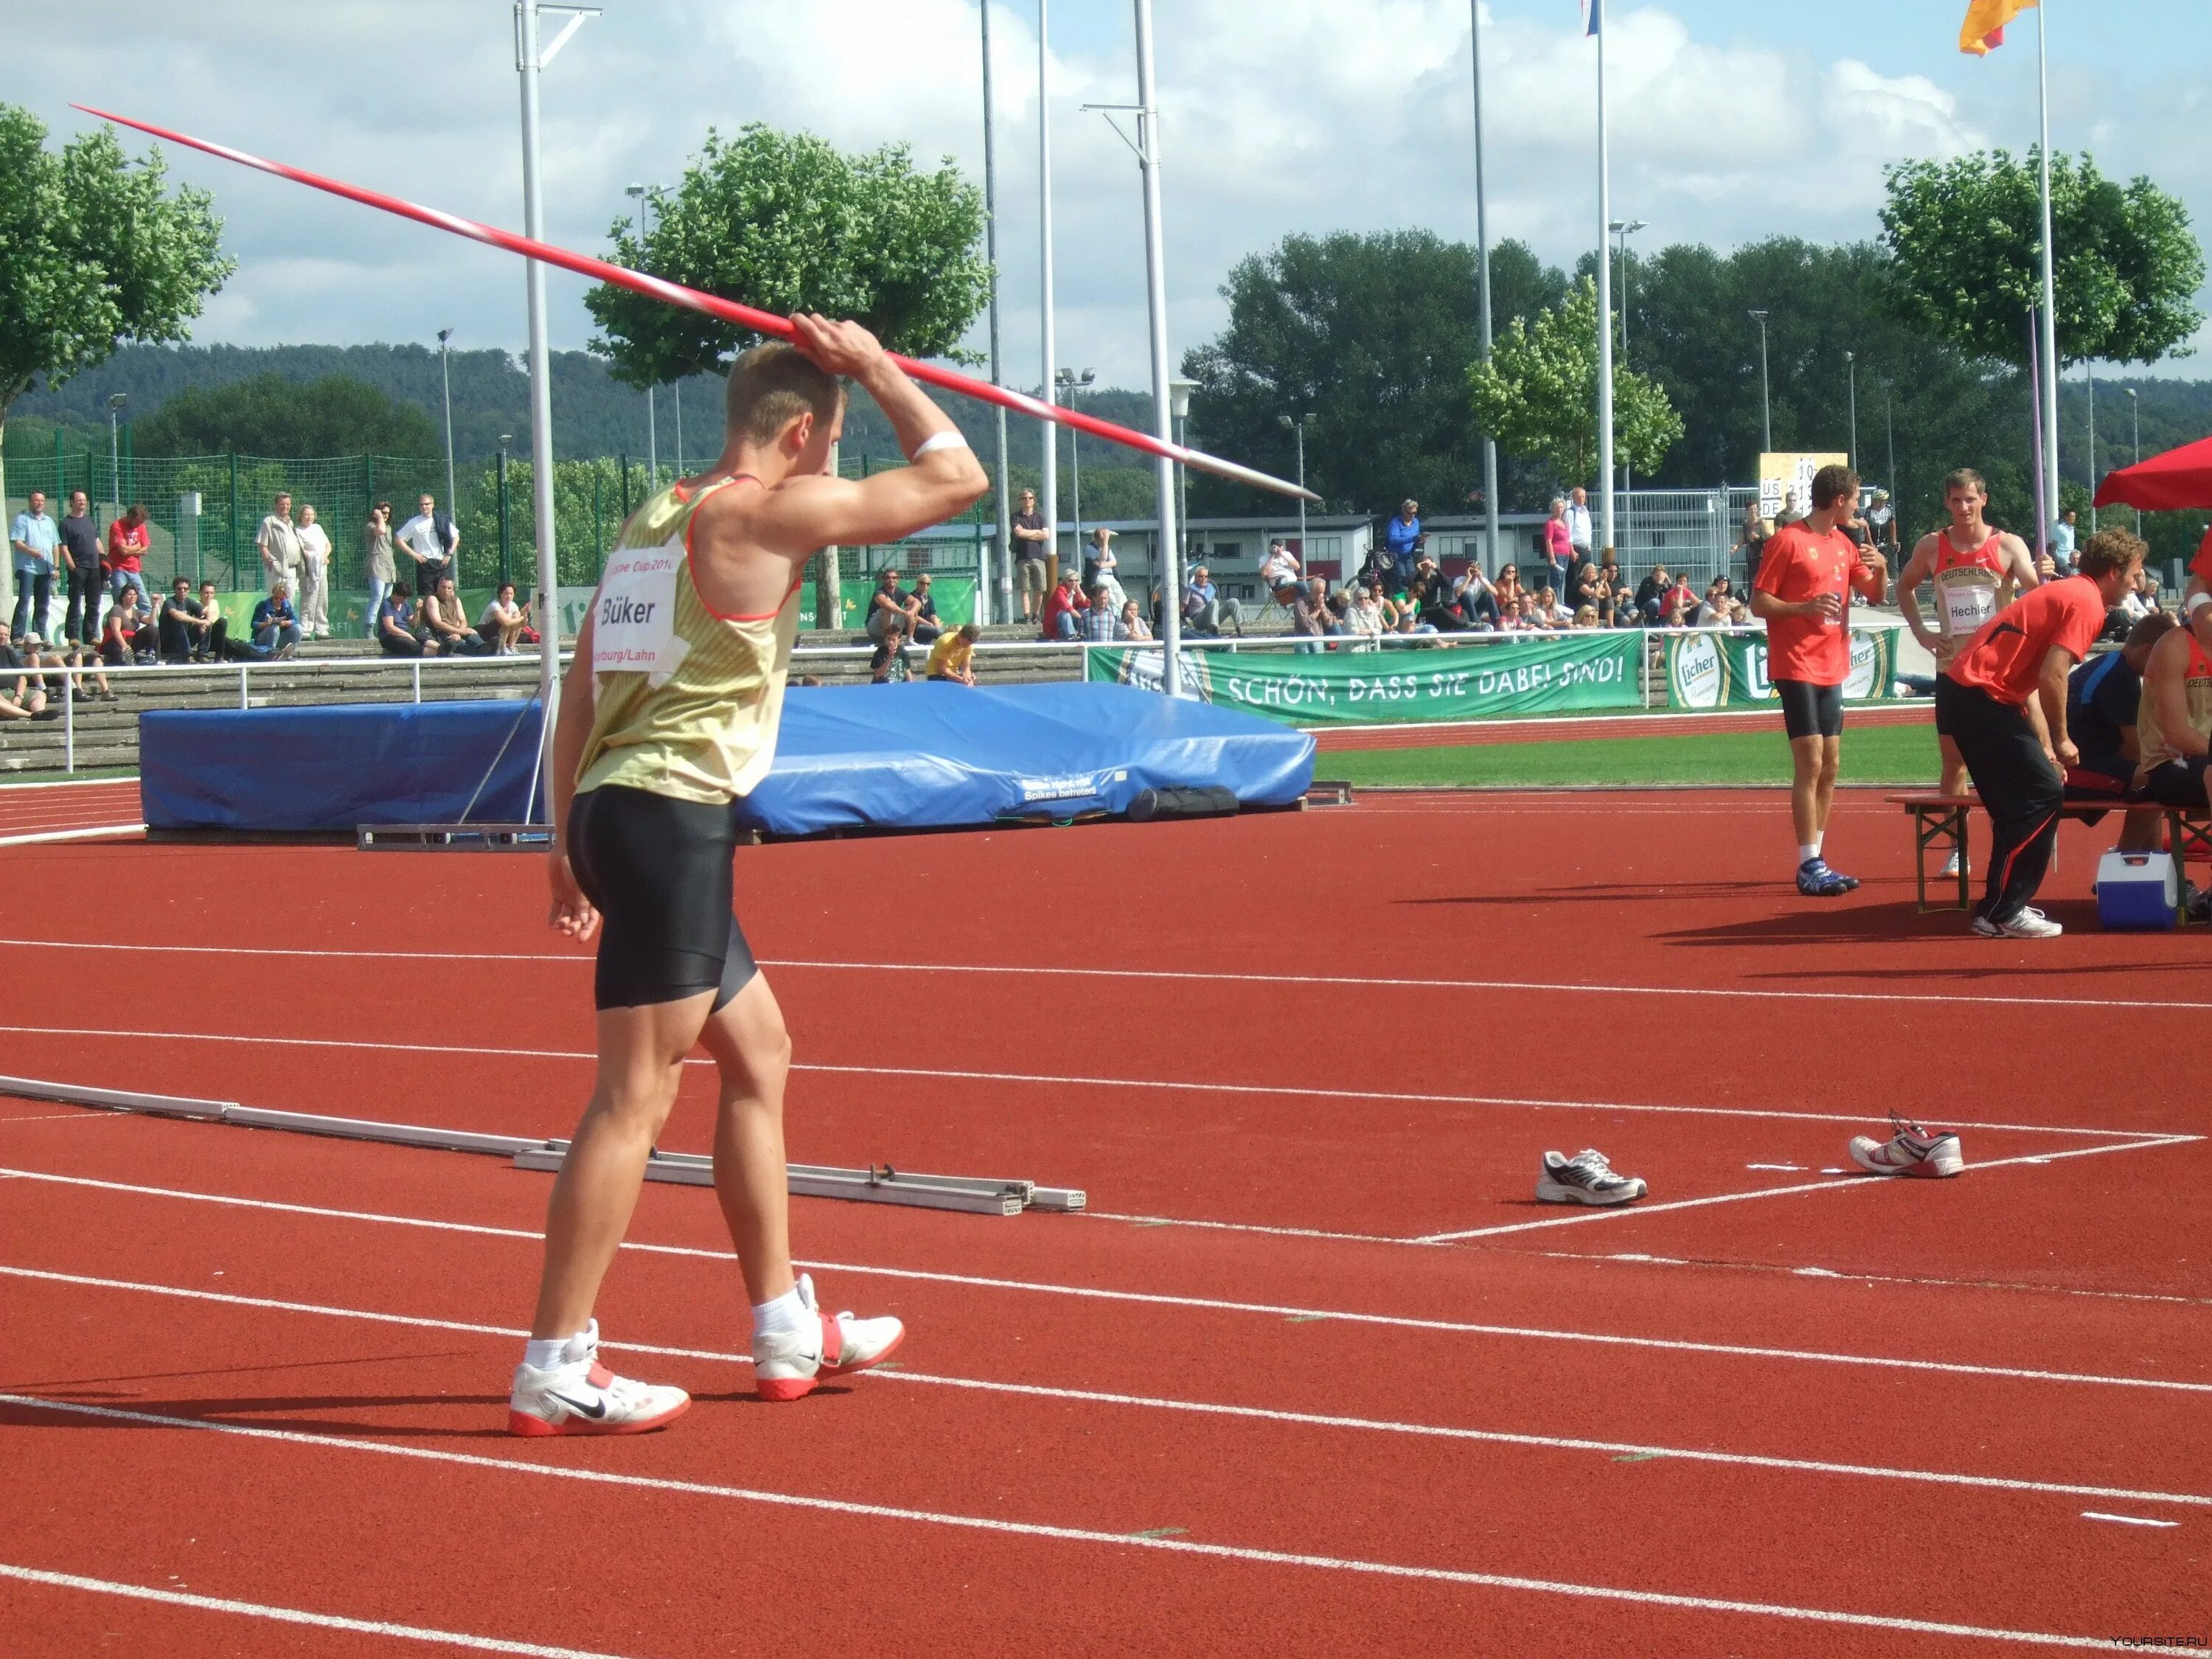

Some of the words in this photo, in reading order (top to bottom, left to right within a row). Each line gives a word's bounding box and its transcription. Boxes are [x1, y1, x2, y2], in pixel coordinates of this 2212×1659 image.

[1763, 483, 1779, 495] US
[1762, 503, 1779, 515] DE
[601, 595, 655, 625] Büker
[1950, 603, 1991, 618] Hechler
[1851, 649, 1871, 667] her
[1681, 655, 1715, 686] Licher
[1228, 673, 1335, 706] SCHÖN,
[1349, 675, 1418, 701] DASS
[1429, 672, 1470, 698] SIE
[1479, 664, 1551, 696] DABEI
[1559, 655, 1624, 687] SIND!
[1024, 790, 1057, 801] Spikes
[1059, 785, 1097, 798] betreten!
